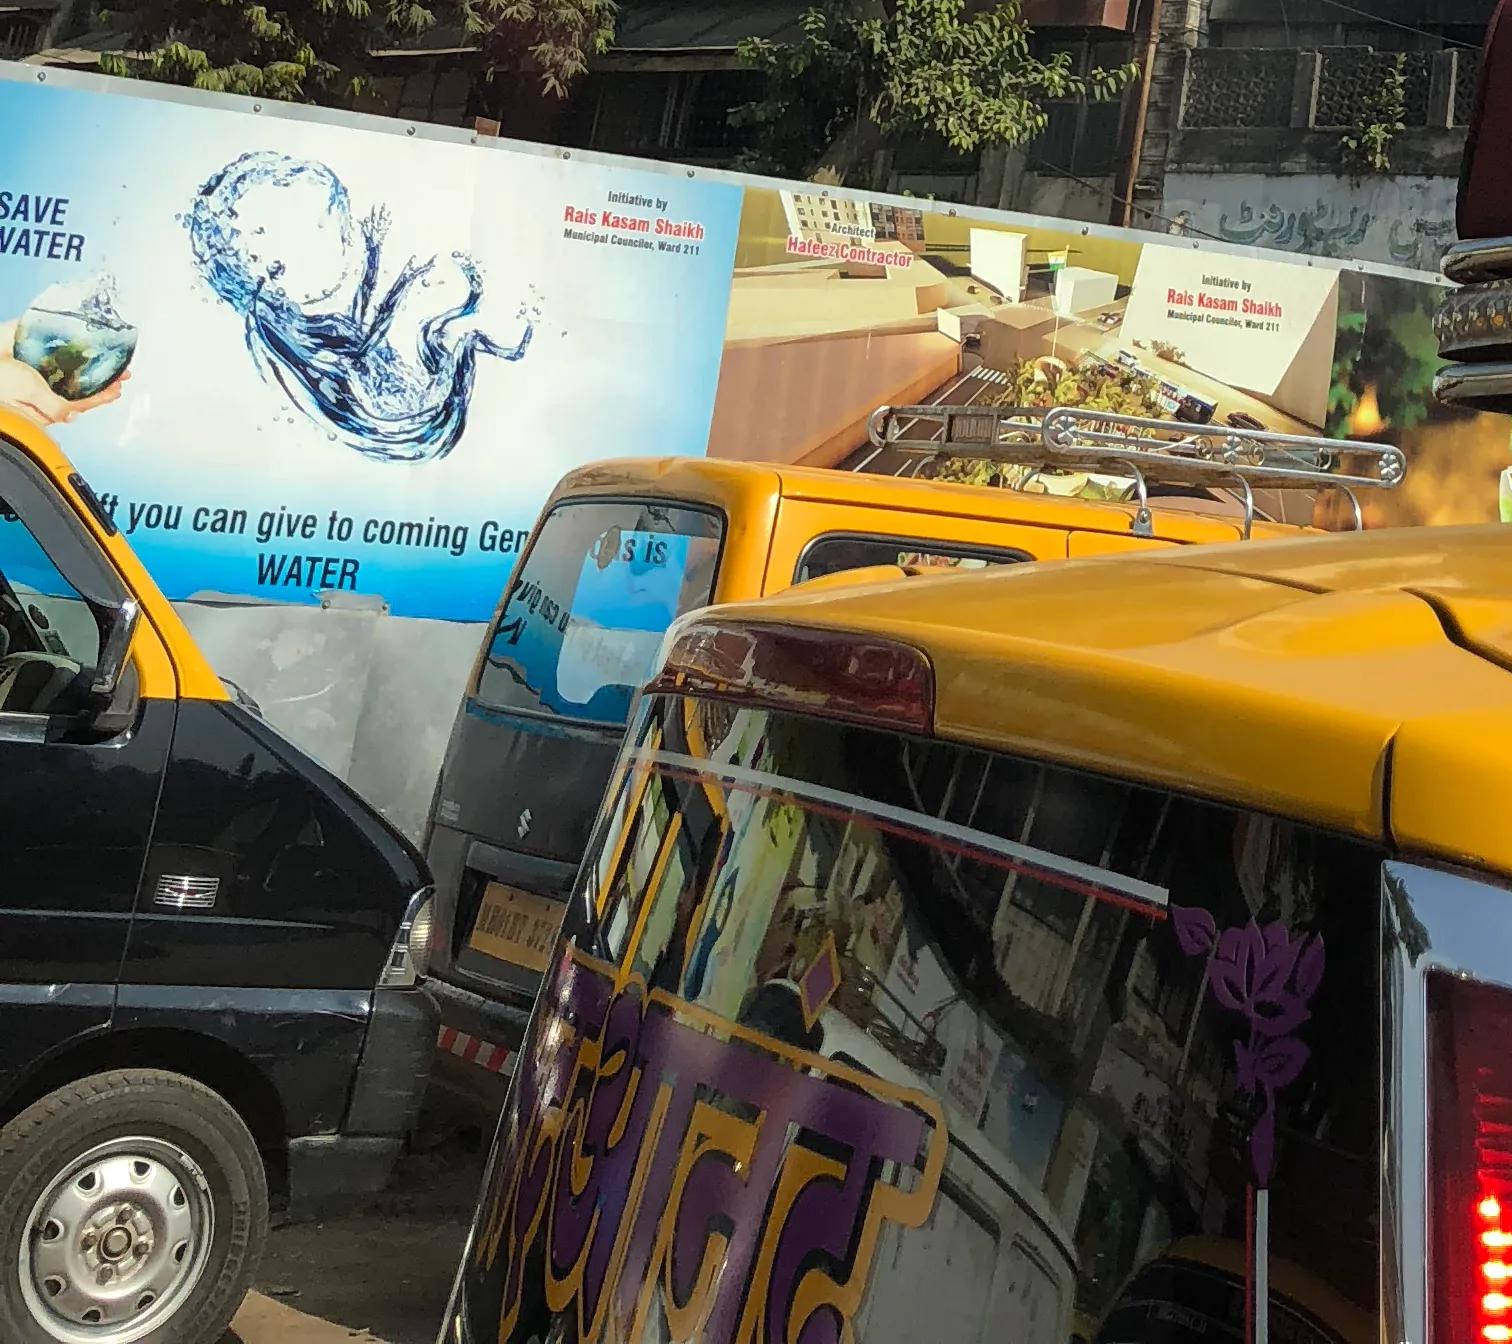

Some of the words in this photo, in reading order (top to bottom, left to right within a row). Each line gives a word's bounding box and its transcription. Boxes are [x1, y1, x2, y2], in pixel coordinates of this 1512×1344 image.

[0, 191, 69, 225] SAVE
[608, 190, 653, 208] Initiative
[656, 198, 668, 212] by
[564, 205, 598, 225] Rais
[601, 210, 650, 232] Kasam
[654, 218, 704, 240] Shaikh
[831, 223, 875, 238] Architect
[563, 228, 609, 244] Municipal
[658, 241, 681, 253] Ward
[683, 244, 700, 255] 211
[840, 244, 912, 267] Contractor
[1201, 274, 1239, 289] Initiative
[1241, 280, 1252, 293] by
[1167, 288, 1195, 307] Rais
[1198, 292, 1238, 312] Kasam
[1241, 298, 1283, 318] Shaikh
[1167, 309, 1205, 324] Municipal
[1245, 319, 1264, 331] Ward
[1265, 323, 1280, 332] 211
[125, 502, 184, 535] you
[192, 506, 248, 535] can
[255, 506, 318, 544] give
[326, 511, 354, 542] to
[363, 516, 469, 557] coming
[257, 553, 360, 591] WATER
